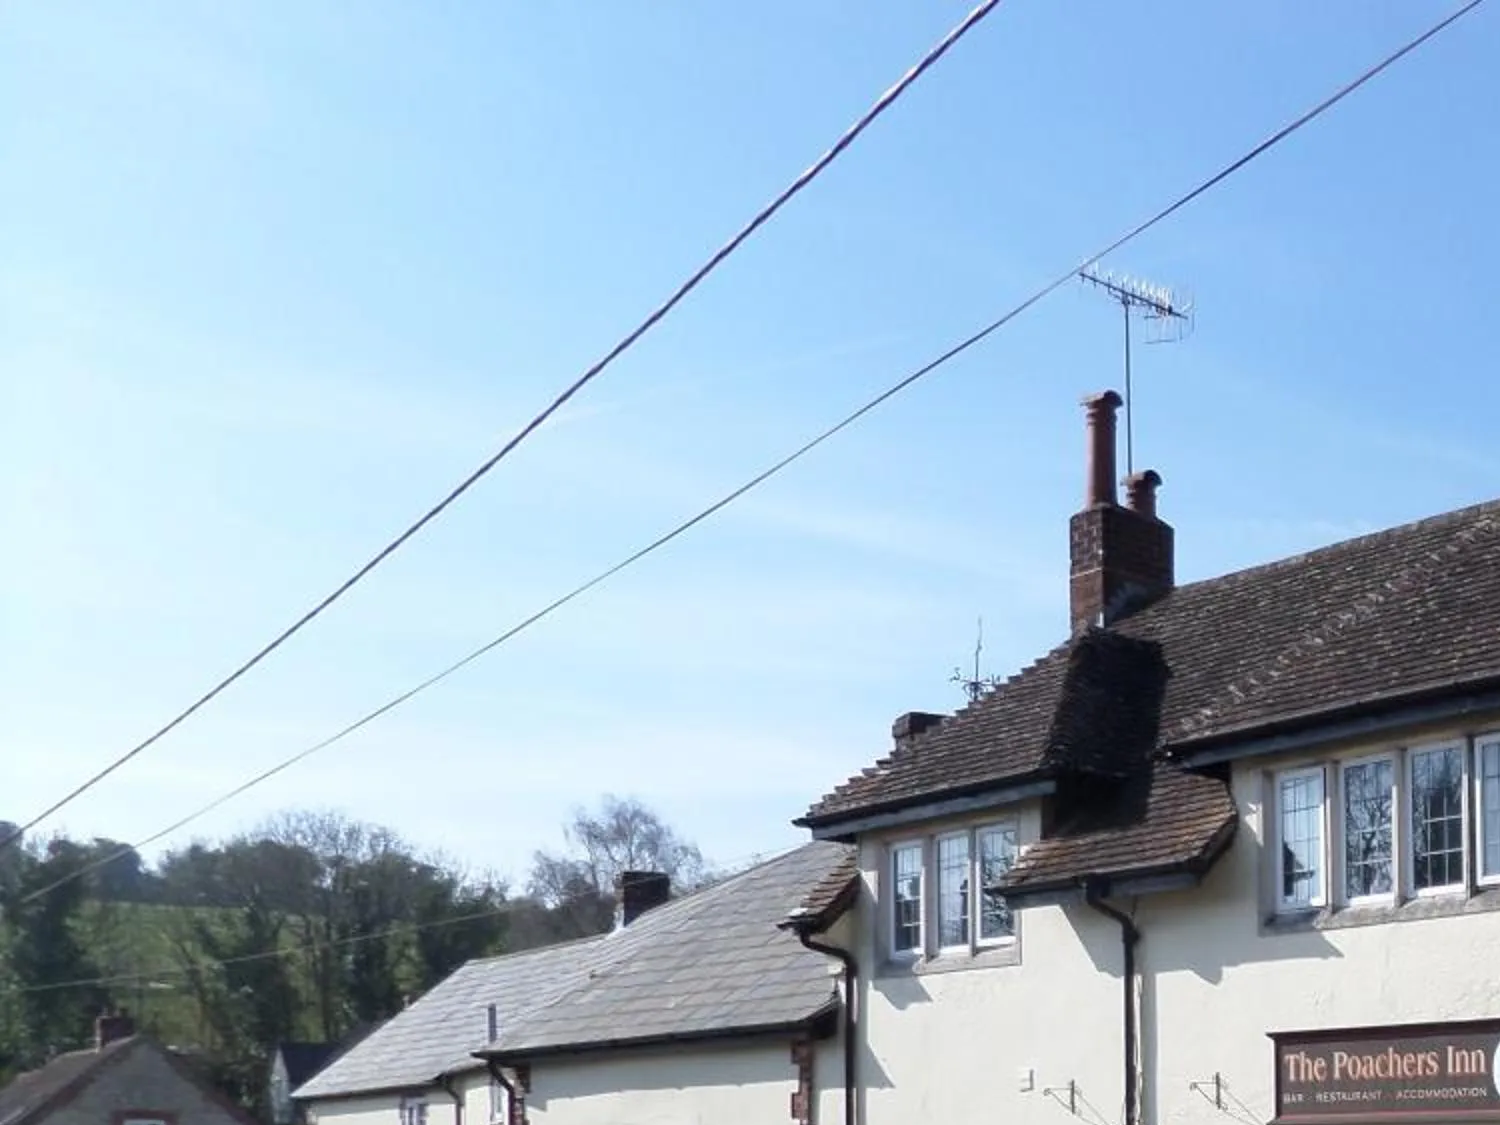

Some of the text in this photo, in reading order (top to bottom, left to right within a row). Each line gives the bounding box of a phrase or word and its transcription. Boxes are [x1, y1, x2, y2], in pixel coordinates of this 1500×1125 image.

[1284, 1045, 1487, 1082] The Poachers Inn
[1283, 1086, 1487, 1104] BAR RESTAURANT ACCOMMODATION
